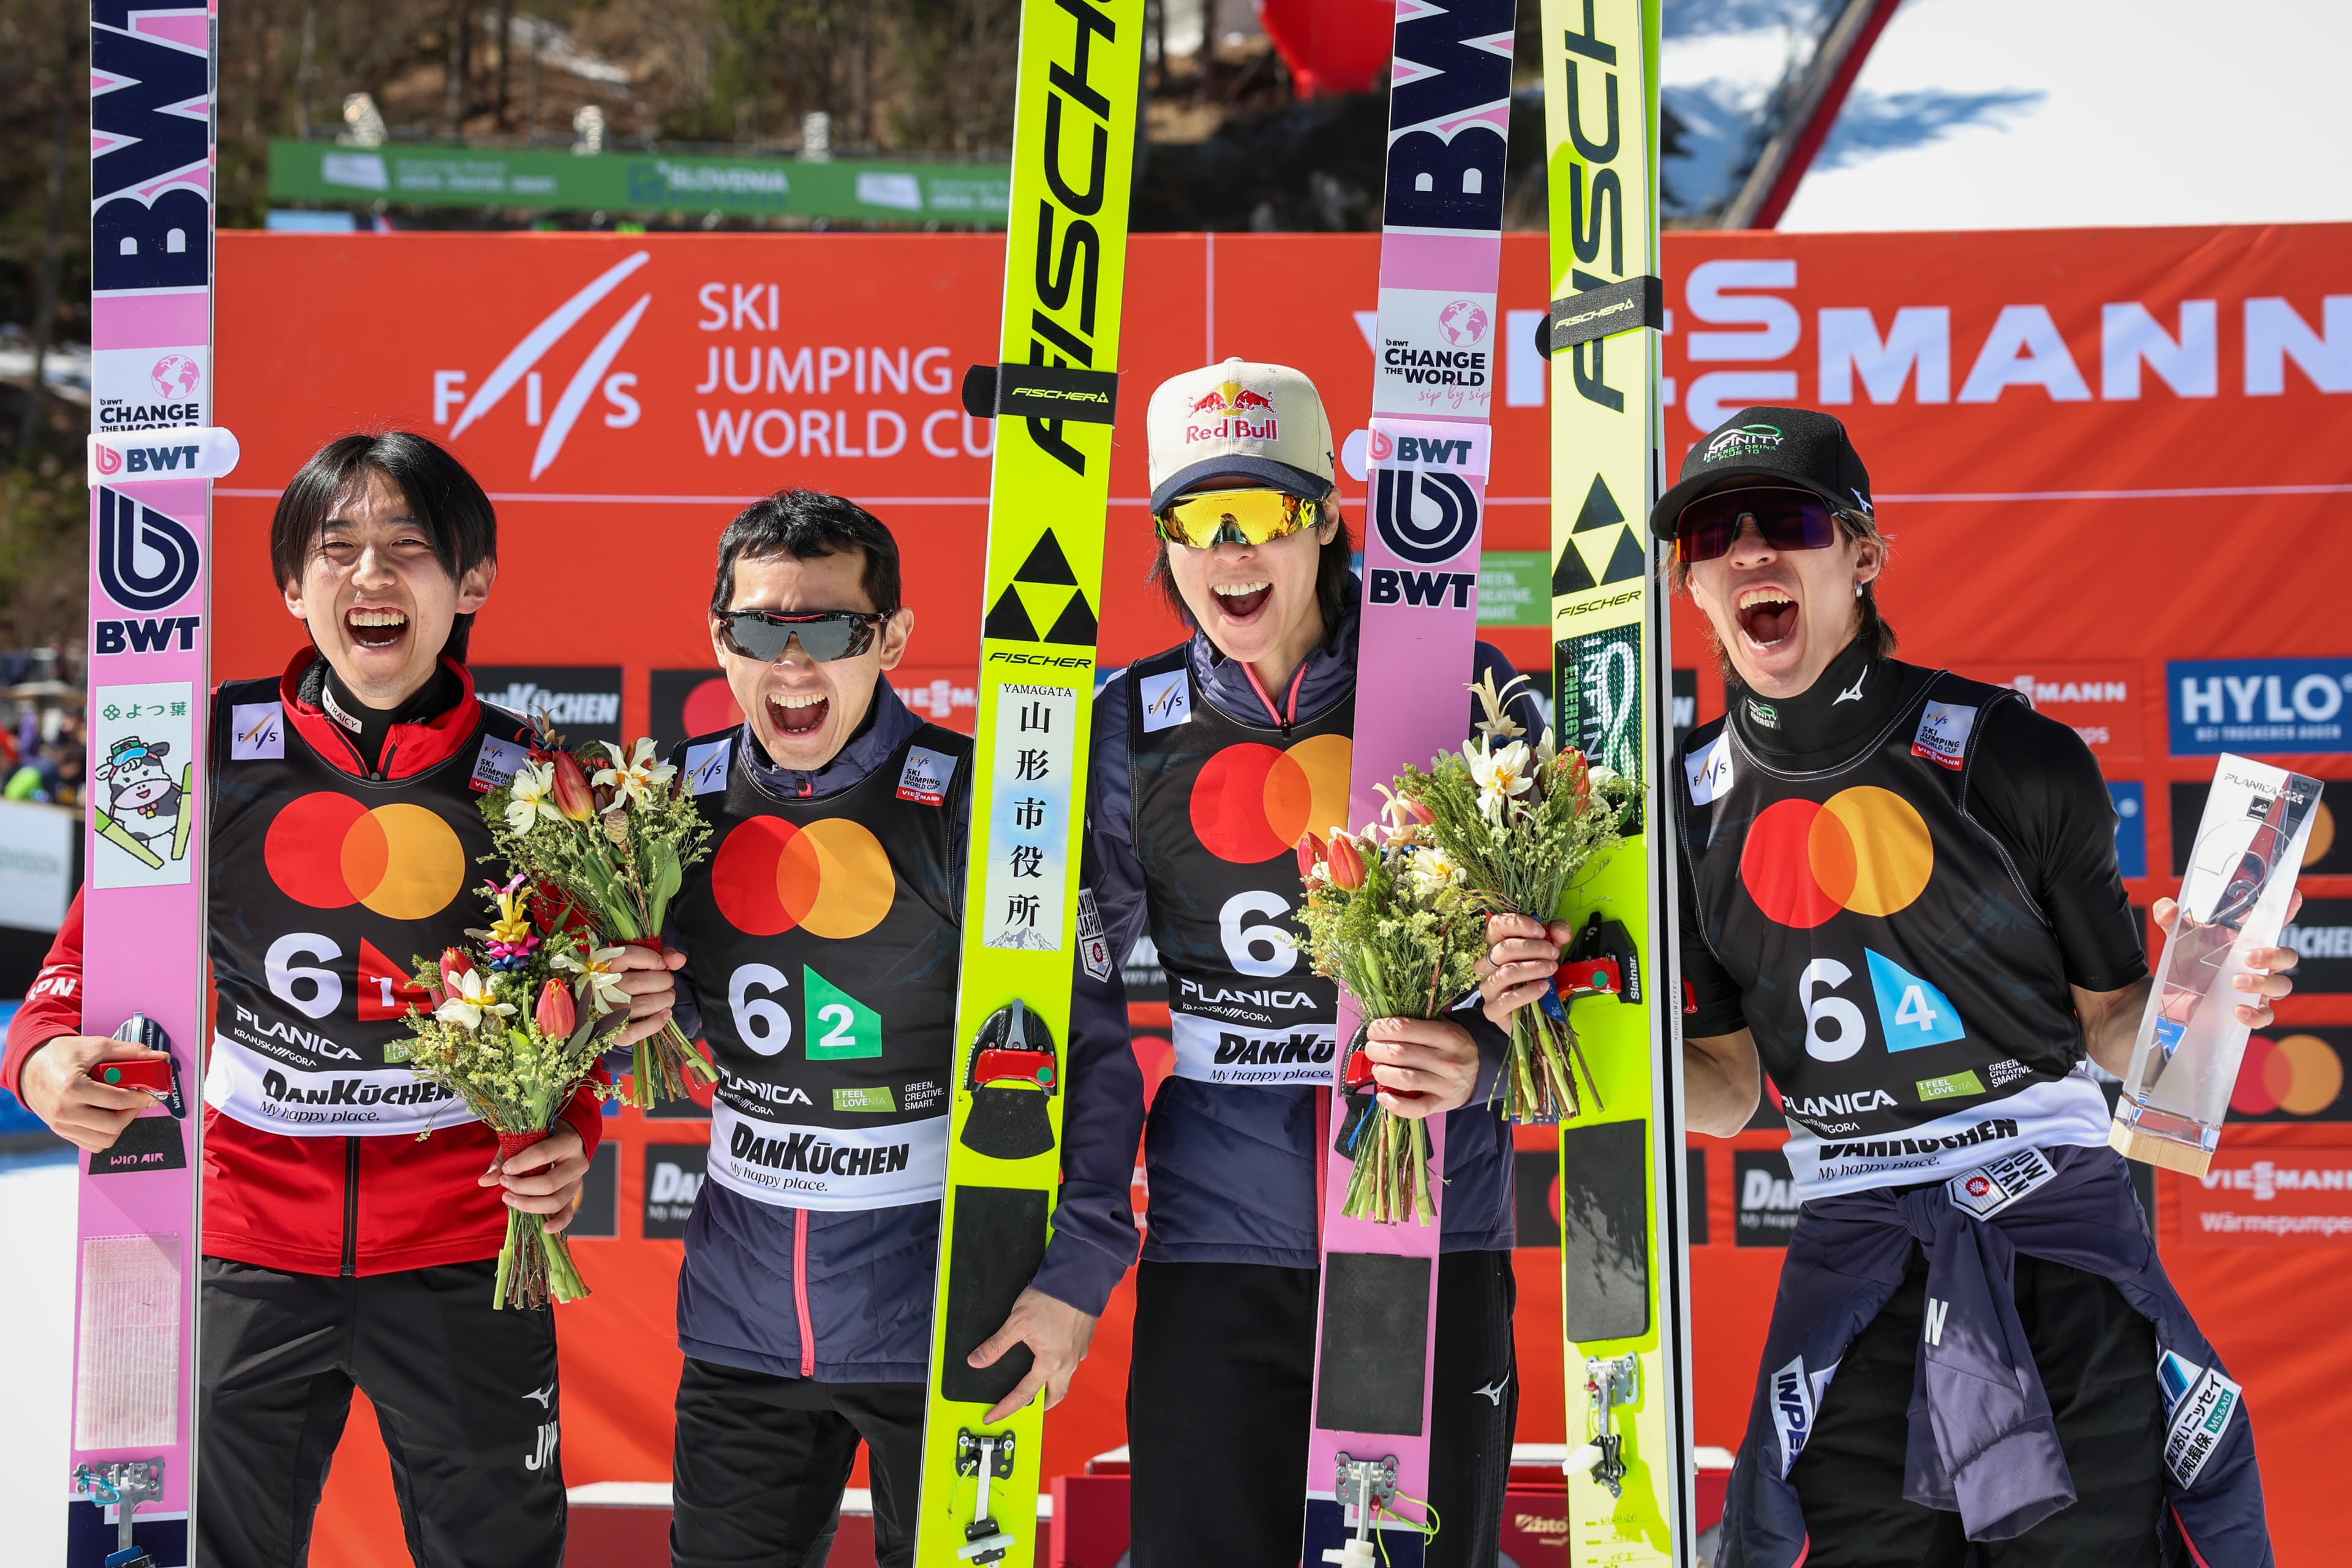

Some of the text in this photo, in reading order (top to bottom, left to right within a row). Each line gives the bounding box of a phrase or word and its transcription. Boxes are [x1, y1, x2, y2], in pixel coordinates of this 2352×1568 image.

[697, 282, 780, 331] SKI
[1555, 302, 1624, 330] FISCHER
[696, 346, 952, 395] JUMPING
[1385, 349, 1485, 370] CHANGE
[1404, 368, 1485, 387] WORLD
[1012, 387, 1098, 402] FISCHER
[1419, 388, 1444, 407] sip
[99, 403, 199, 423] CHANGE
[696, 409, 995, 458] WORLD CU
[1186, 417, 1277, 444] Red Bull
[127, 445, 199, 473] BWT
[1397, 437, 1472, 465] BWT
[1718, 450, 1743, 461] PLUS
[1369, 568, 1476, 609] BWT
[1556, 590, 1642, 619] FISCHER
[95, 615, 202, 655] BWT
[989, 652, 1092, 669] FISCHER
[1003, 683, 1073, 698] YAMAGATA
[1583, 637, 1603, 761] INFIN
[126, 701, 187, 720] よつ葉
[329, 703, 358, 728] TRAICY
[1920, 731, 1961, 748] JUMPING
[1922, 725, 1938, 736] SKI
[1919, 736, 1943, 750] WORLD
[480, 758, 494, 767] SKI
[1917, 746, 1960, 766] VIESSMANN
[477, 771, 500, 782] WORLD
[905, 774, 941, 786] JUMPING
[907, 768, 921, 777] SKI
[2224, 772, 2277, 796] PLANICA
[902, 790, 940, 802] VIESSMANN
[903, 779, 926, 790] WORLD
[1005, 701, 1052, 927] 山形市役所
[1218, 890, 1298, 978] 6
[264, 932, 342, 1019] 6
[370, 976, 395, 1007] 1
[1180, 978, 1318, 1009] PLANICA
[728, 963, 791, 1056] 6
[1241, 1011, 1273, 1023] GORA
[1798, 957, 1866, 1062] 6
[1894, 984, 1937, 1031] 4
[235, 1004, 363, 1061] PLANICA
[817, 1003, 856, 1047] 2
[288, 1052, 318, 1067] GORA
[1988, 1058, 2021, 1071] GREEN.
[716, 1065, 813, 1106] PLANICA
[905, 1081, 935, 1093] GREEN.
[1209, 1068, 1334, 1083] My happy place.
[1925, 1078, 1951, 1089] FEEL
[1991, 1074, 2024, 1088] SMART.
[842, 1090, 866, 1099] FEEL
[905, 1089, 944, 1102] CREATIVE.
[905, 1099, 935, 1110] SMART.
[1781, 1089, 1898, 1118] PLANICA
[258, 1101, 380, 1124] My happy place.
[749, 1102, 774, 1116] GORA
[140, 1152, 165, 1163] AIR
[1817, 1156, 1940, 1181] My happy place.
[729, 1162, 828, 1192] My happy place.
[2199, 1210, 2352, 1237] Wärmepumpe
[2166, 1373, 2222, 1467] あいおいニッセイ
[2207, 1393, 2232, 1432] MS&AD
[2176, 1431, 2215, 1484] 同和損保
